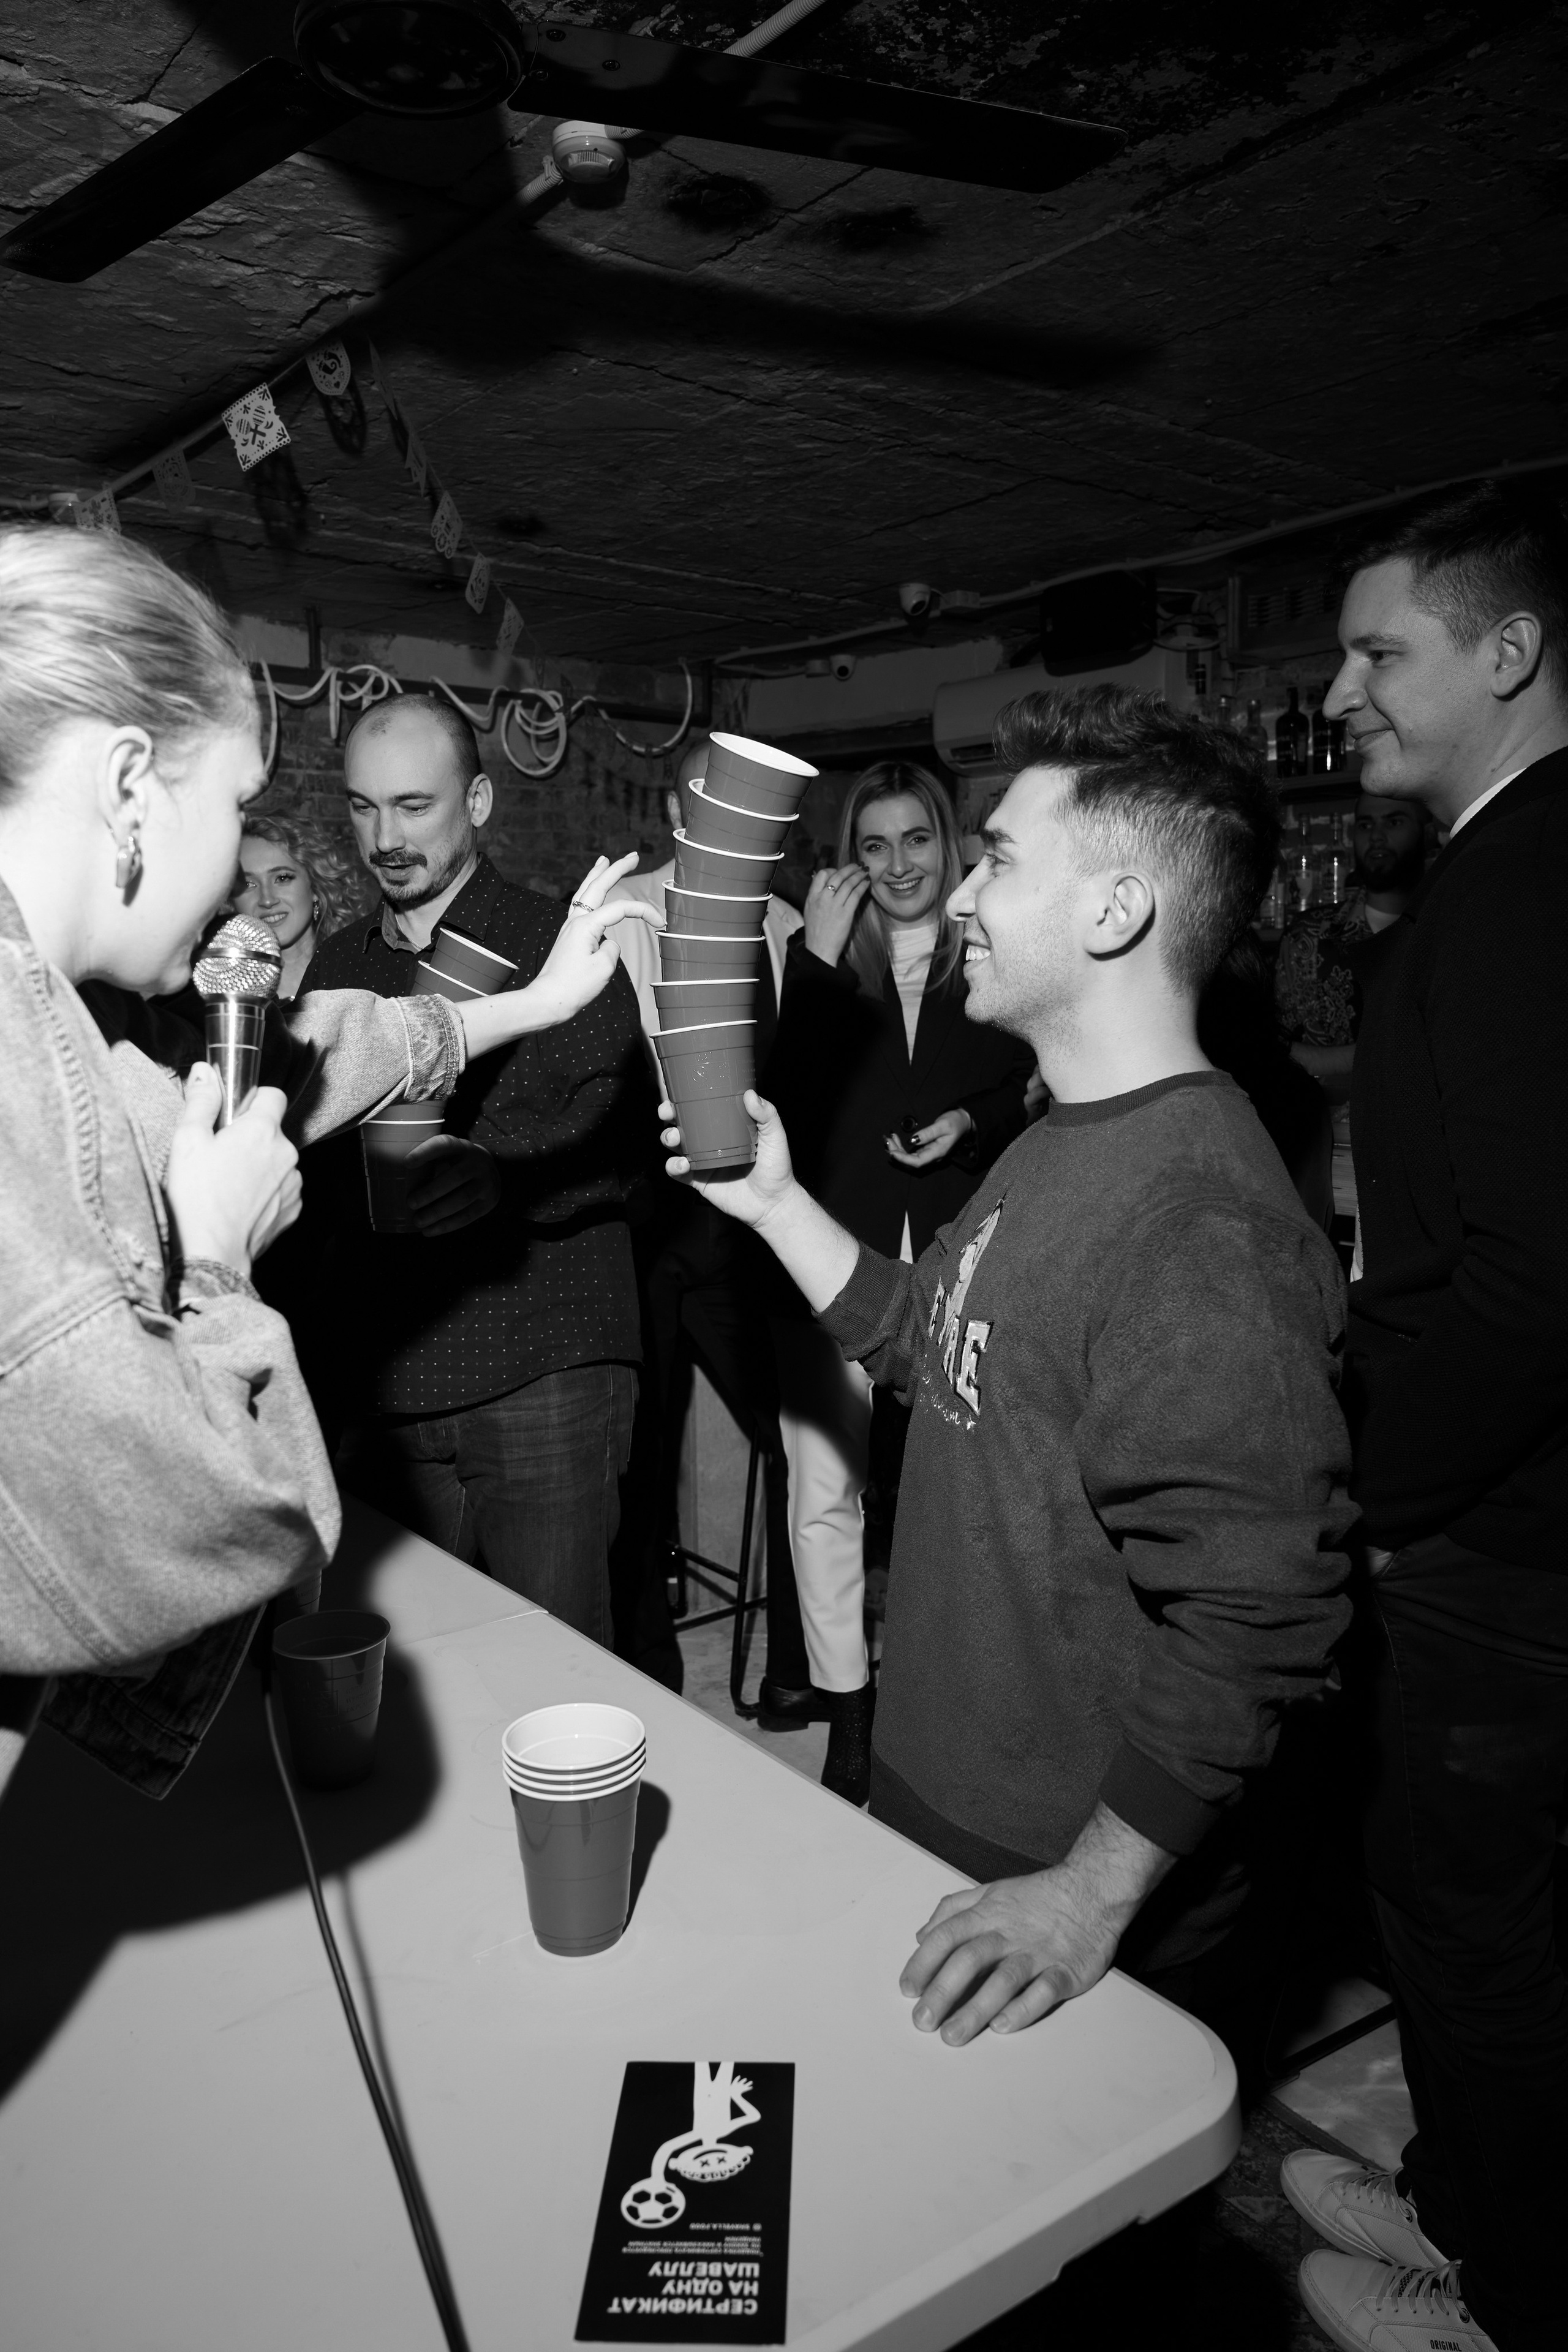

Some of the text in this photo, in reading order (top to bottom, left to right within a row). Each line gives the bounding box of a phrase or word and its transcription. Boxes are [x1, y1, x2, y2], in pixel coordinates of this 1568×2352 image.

[647, 2261, 760, 2278] ШАВЕЛЛУ
[661, 2277, 759, 2296] НА ОДНУ
[607, 2297, 758, 2315] СЕРТИФИКАТ
[1430, 2340, 1462, 2352] ORIGINAL
